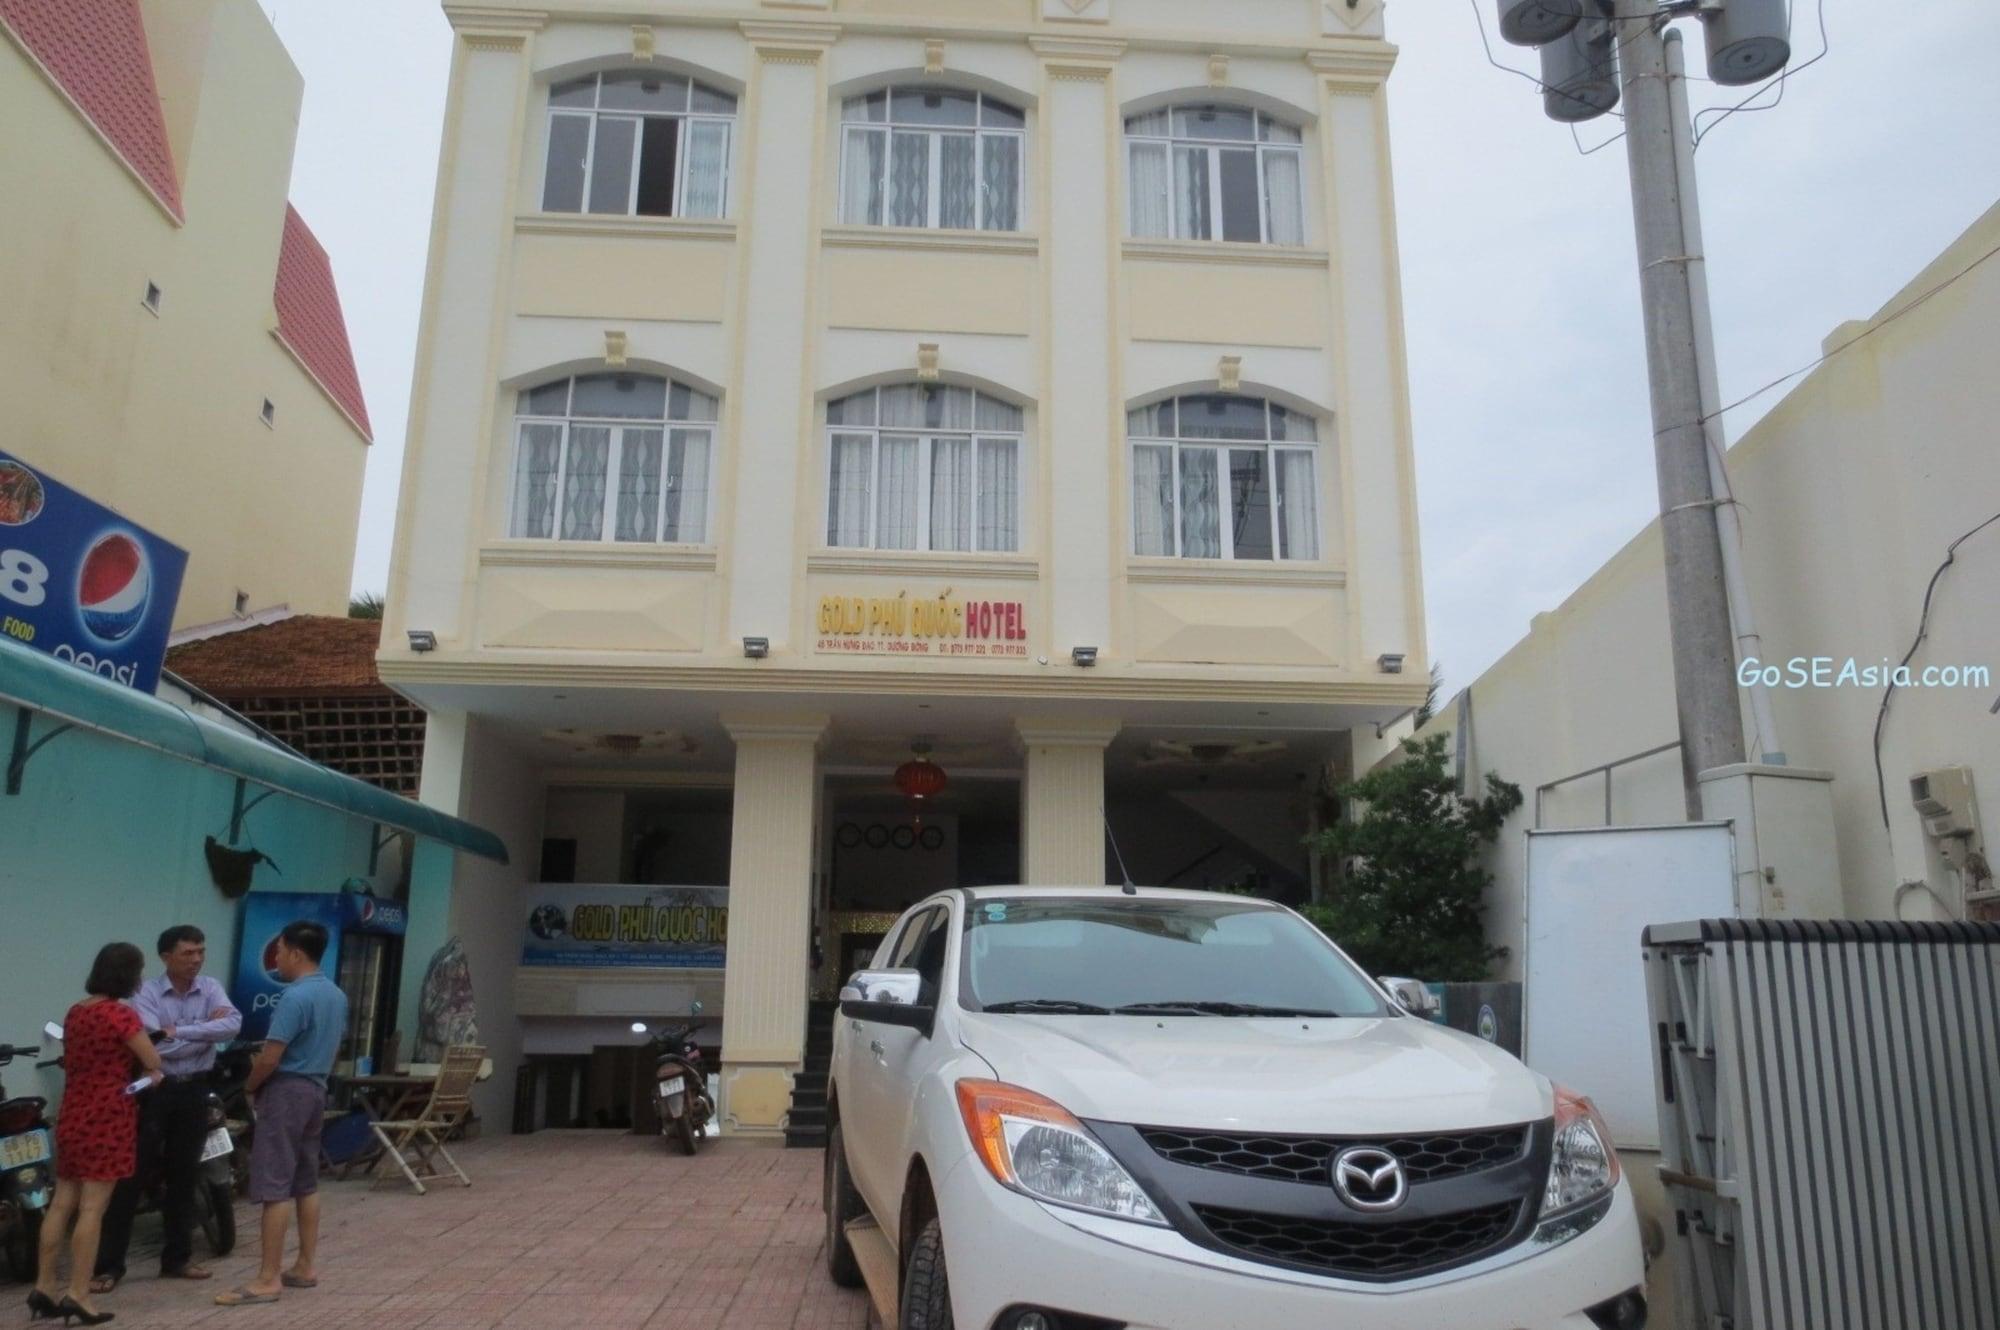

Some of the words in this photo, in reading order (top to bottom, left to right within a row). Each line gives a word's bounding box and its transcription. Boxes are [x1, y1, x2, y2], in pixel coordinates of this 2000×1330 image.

[0, 549, 48, 606] 8
[3, 616, 35, 641] FOOD
[816, 595, 865, 635] GOLD
[867, 589, 906, 637] PHÚ
[911, 586, 962, 638] QUỐC
[966, 600, 1026, 640] HOTEL
[573, 904, 614, 941] GOLD
